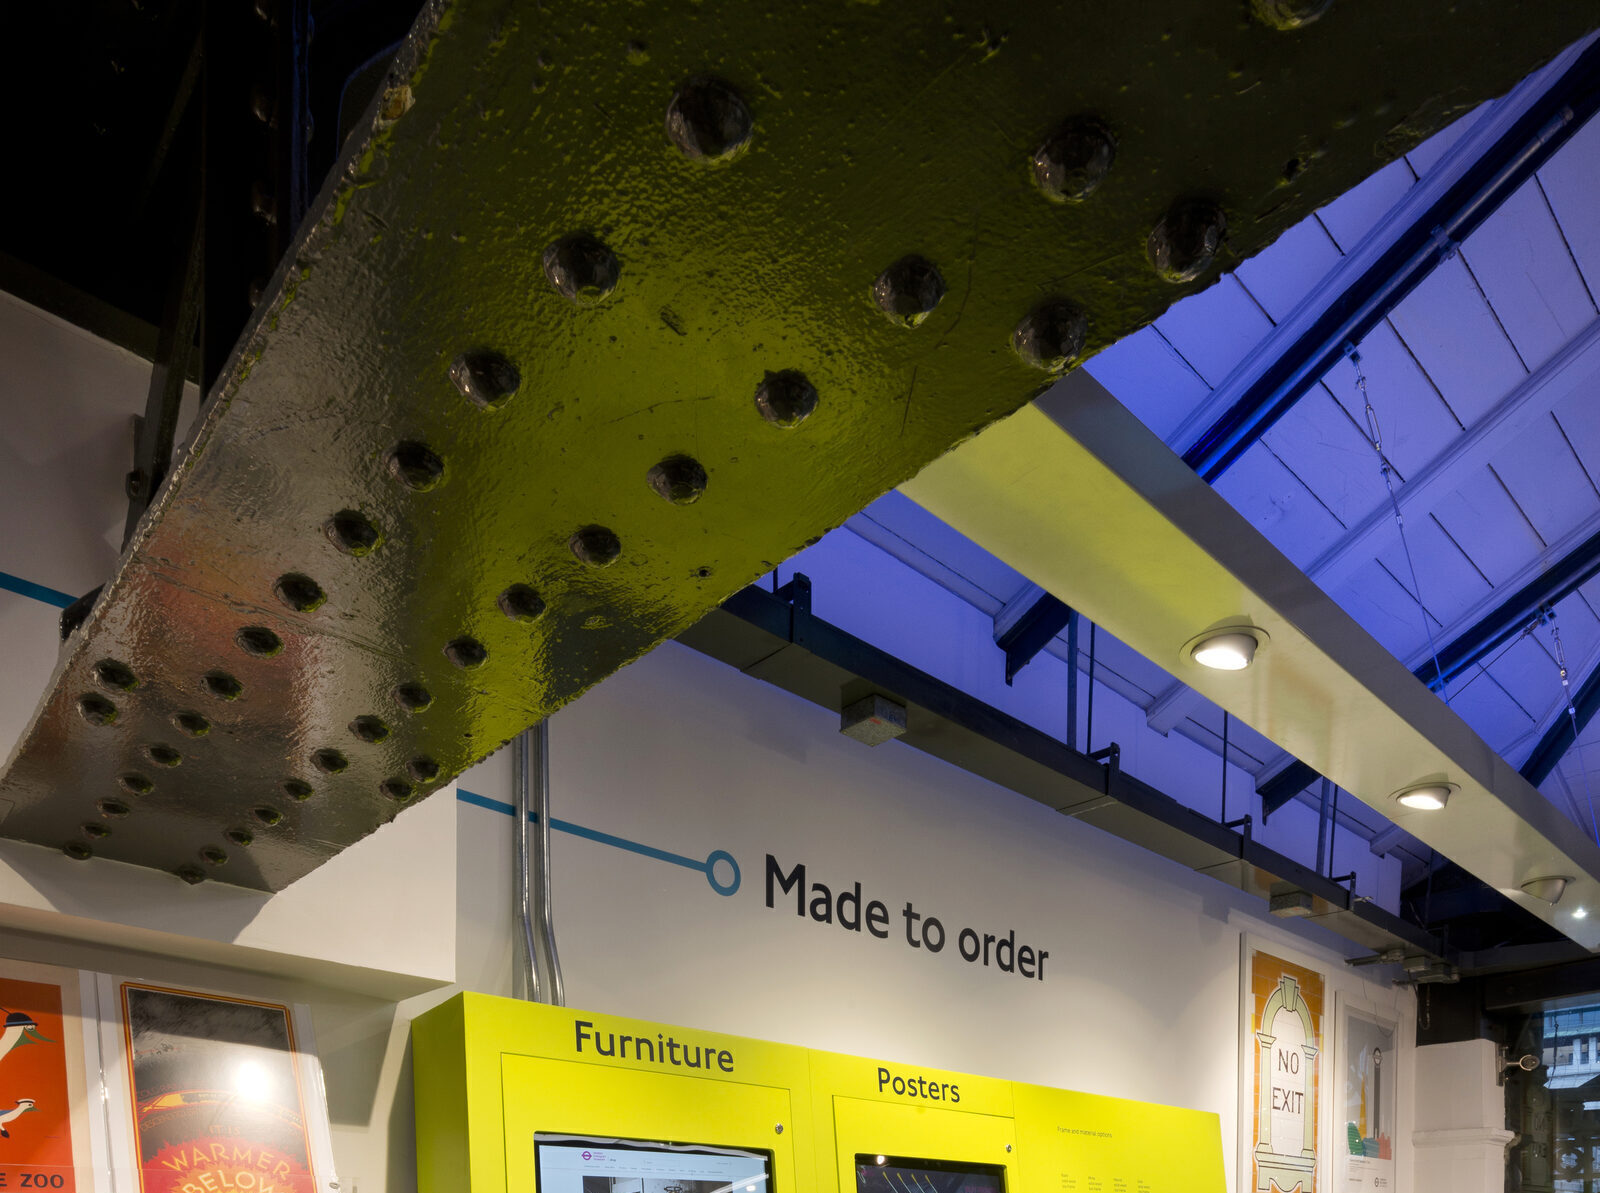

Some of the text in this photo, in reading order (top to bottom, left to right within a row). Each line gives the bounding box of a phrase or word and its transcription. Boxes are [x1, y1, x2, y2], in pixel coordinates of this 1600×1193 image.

[765, 853, 1049, 981] Made to order
[575, 1020, 734, 1073] Furniture
[1278, 1048, 1300, 1075] NO
[877, 1067, 960, 1103] Posters
[1272, 1087, 1304, 1114] EXIT
[161, 1143, 291, 1181] WARMER
[20, 1173, 65, 1189] ZOO
